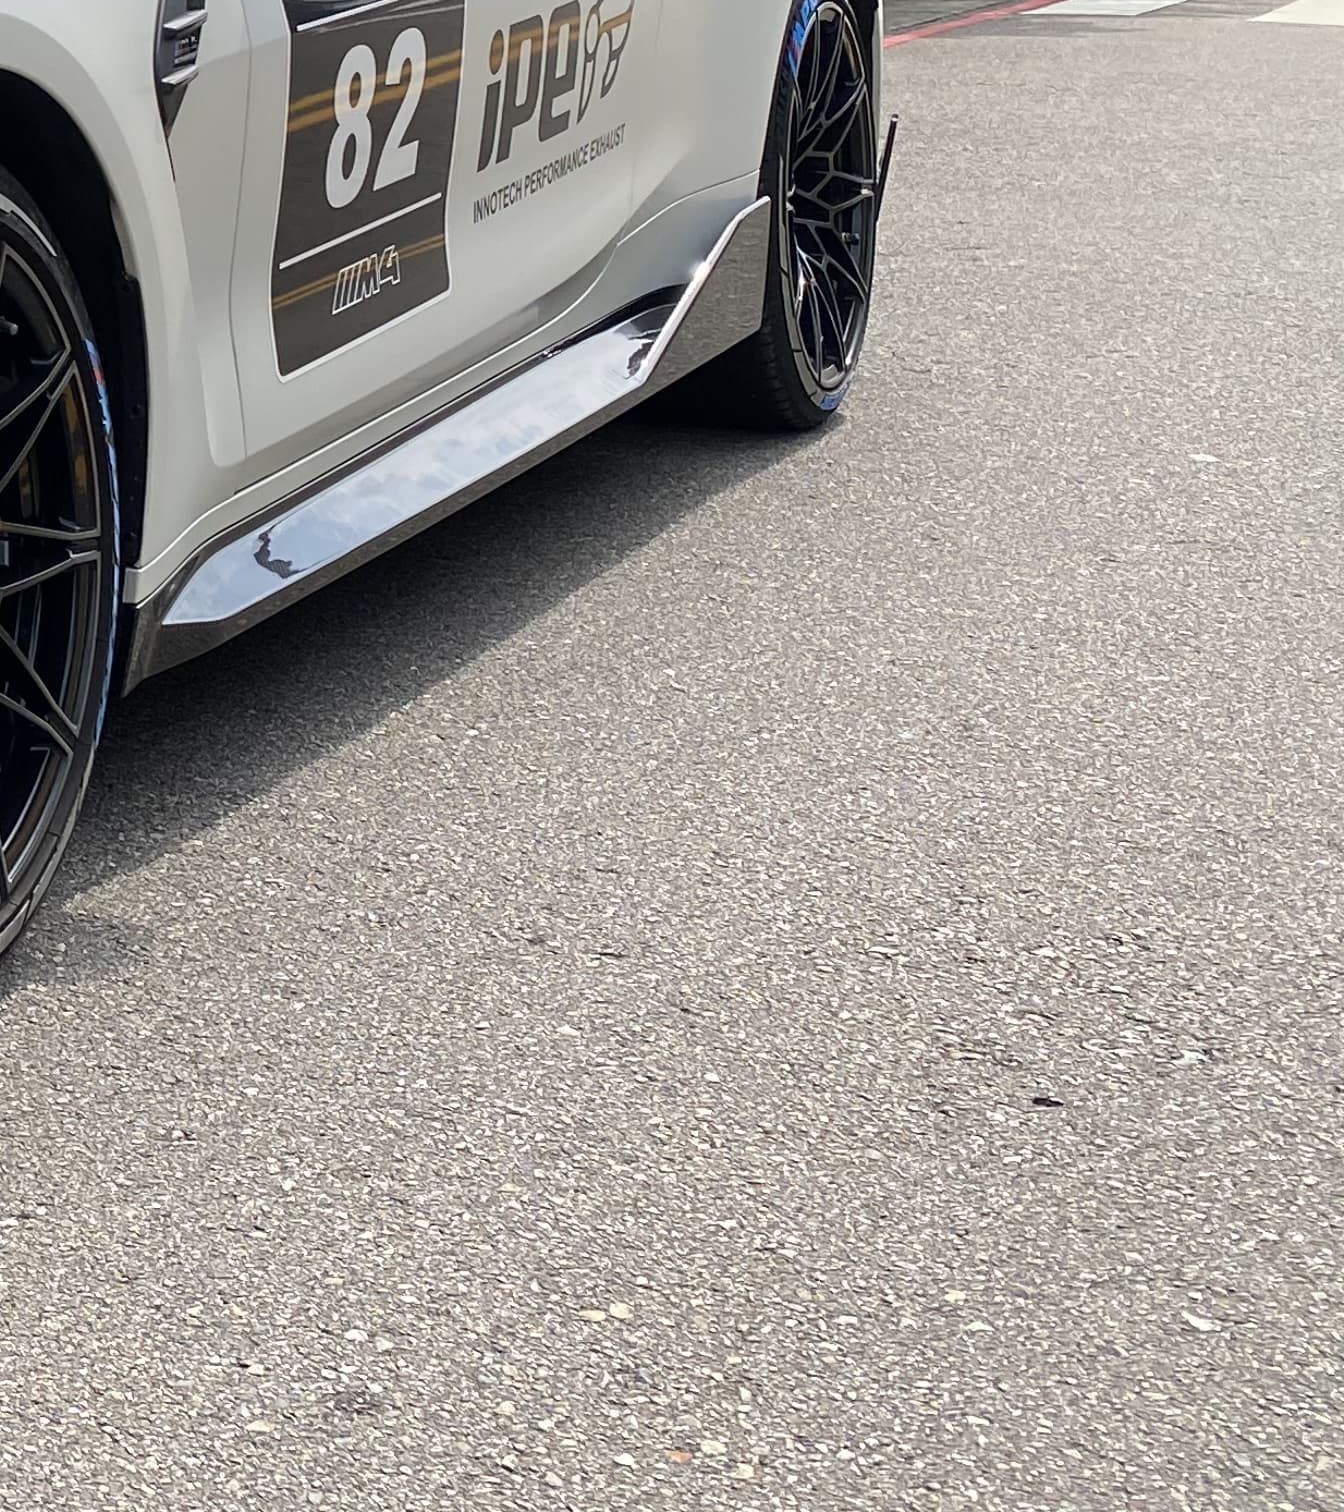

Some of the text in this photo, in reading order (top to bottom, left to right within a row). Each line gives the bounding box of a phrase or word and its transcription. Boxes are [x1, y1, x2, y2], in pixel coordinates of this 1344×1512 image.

[324, 26, 428, 209] 82
[472, 122, 627, 224] INNOTECH PERFORMANCE EXHAUST
